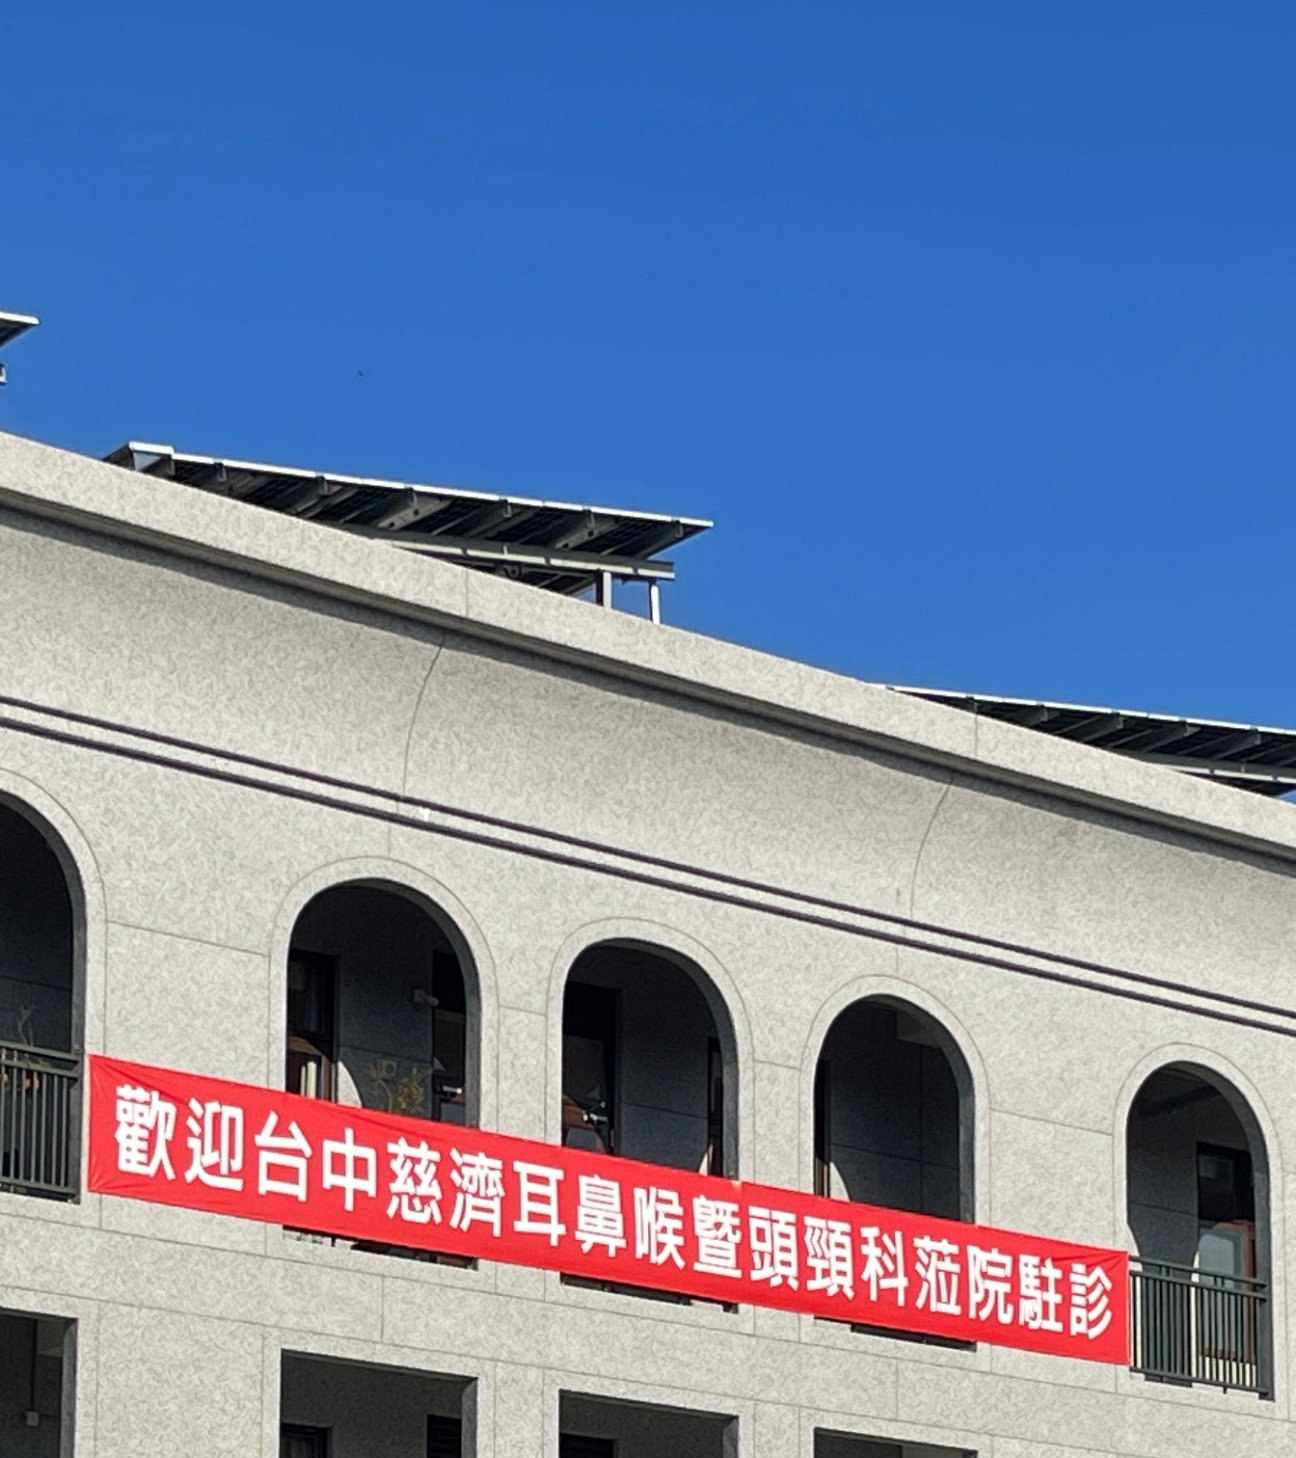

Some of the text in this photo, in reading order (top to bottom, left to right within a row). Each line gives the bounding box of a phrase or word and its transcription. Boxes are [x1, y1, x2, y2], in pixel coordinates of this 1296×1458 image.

[115, 1084, 1112, 1339] 歡迎台中慈濟耳鼻喉暨頭頸科蒞院駐診
